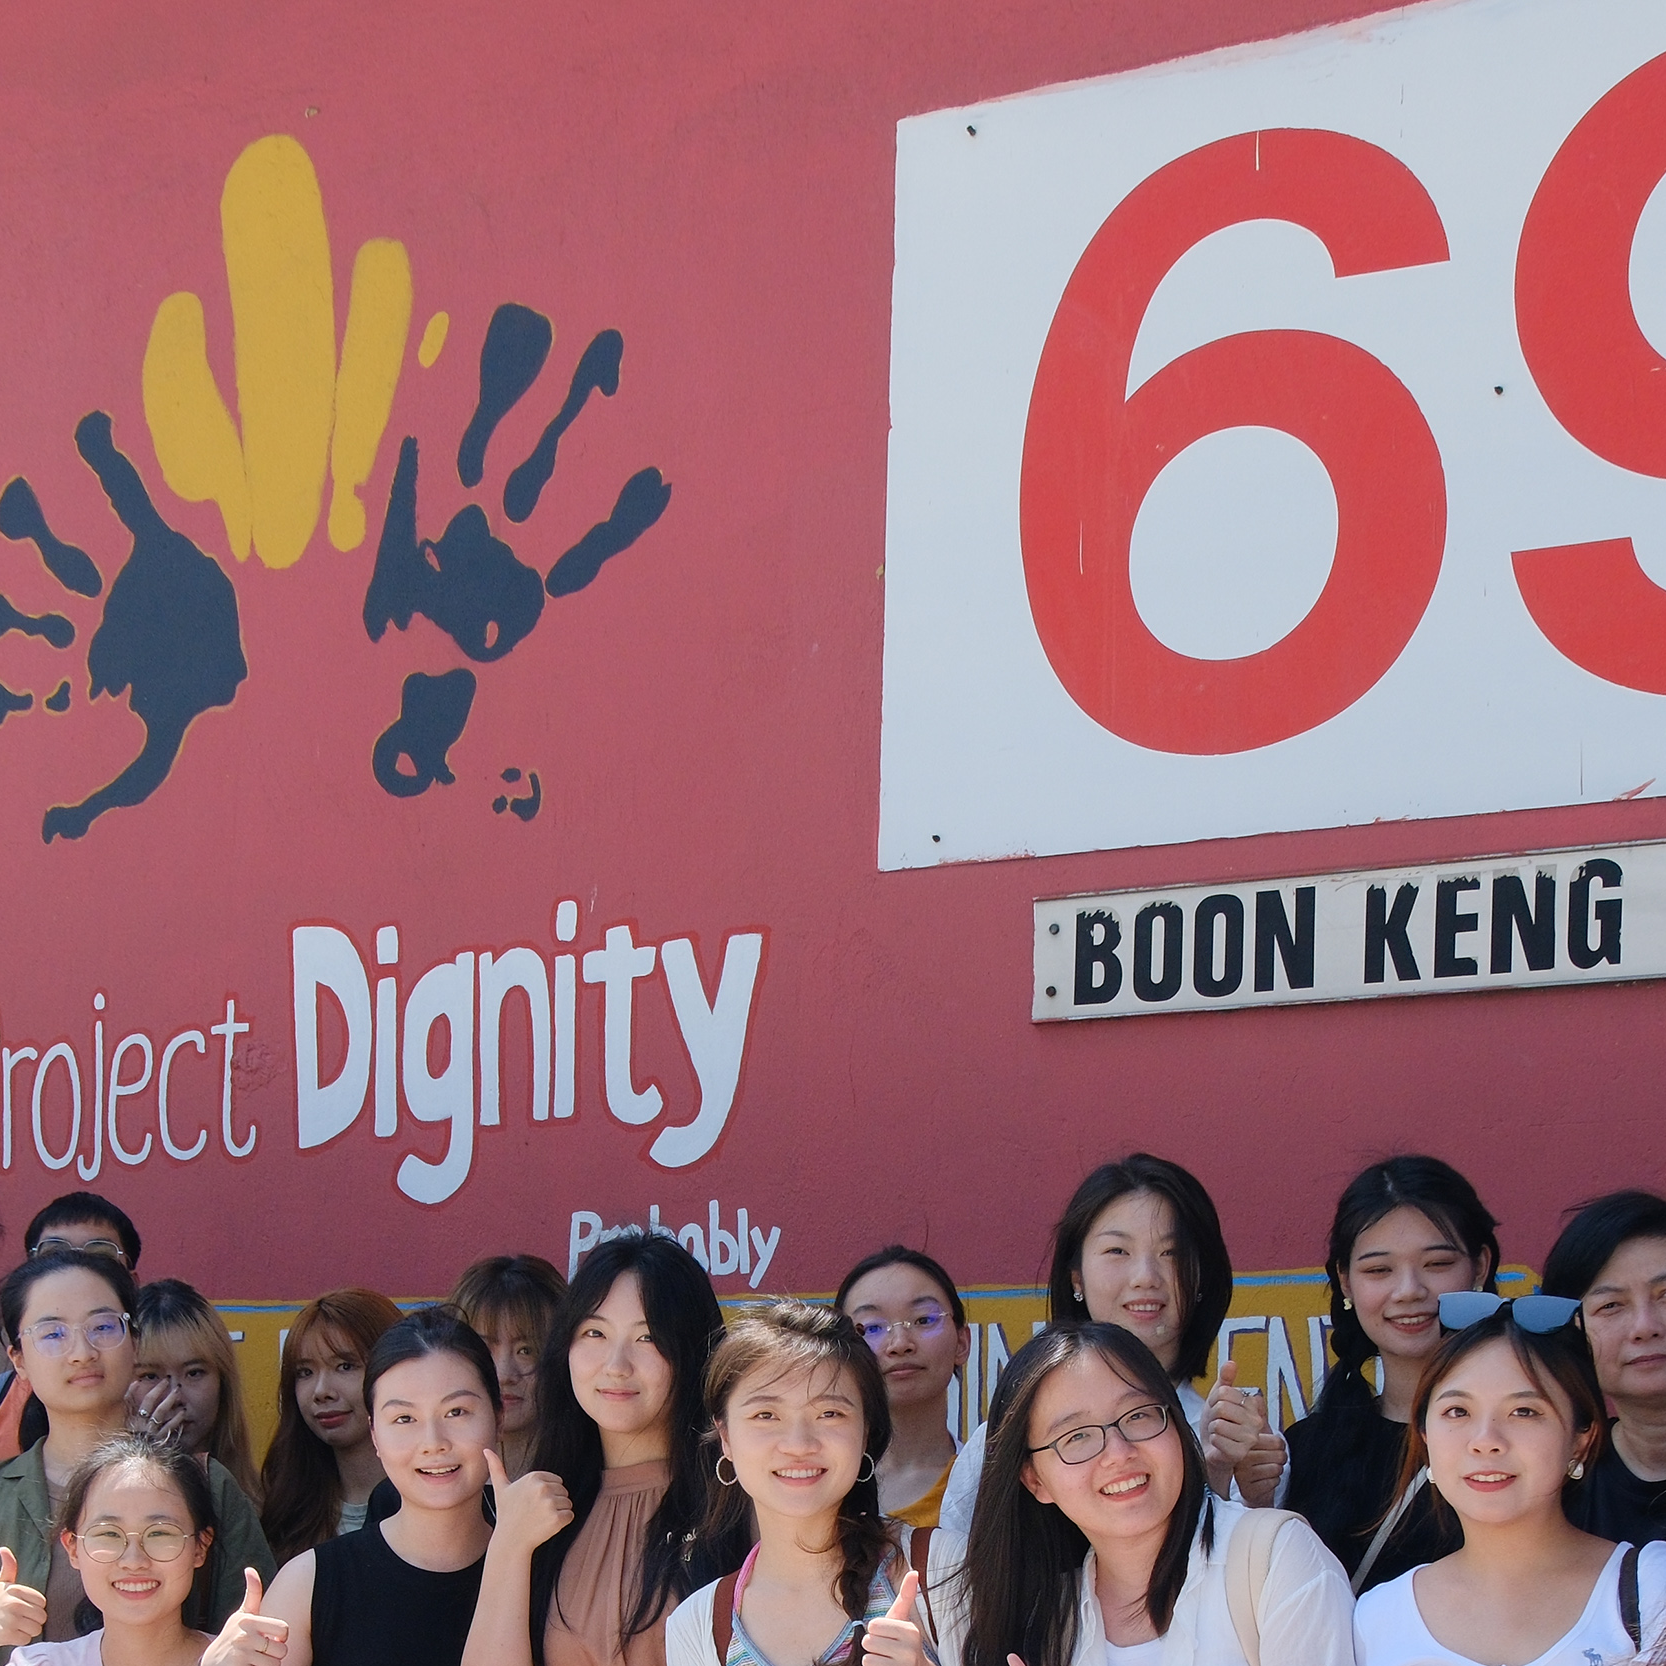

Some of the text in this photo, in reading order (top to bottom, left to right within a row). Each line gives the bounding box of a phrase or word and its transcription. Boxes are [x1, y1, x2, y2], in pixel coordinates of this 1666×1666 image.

[1073, 886, 1317, 1006] BOON
[1364, 858, 1624, 984] KENG
[293, 899, 763, 1204] Dignity
